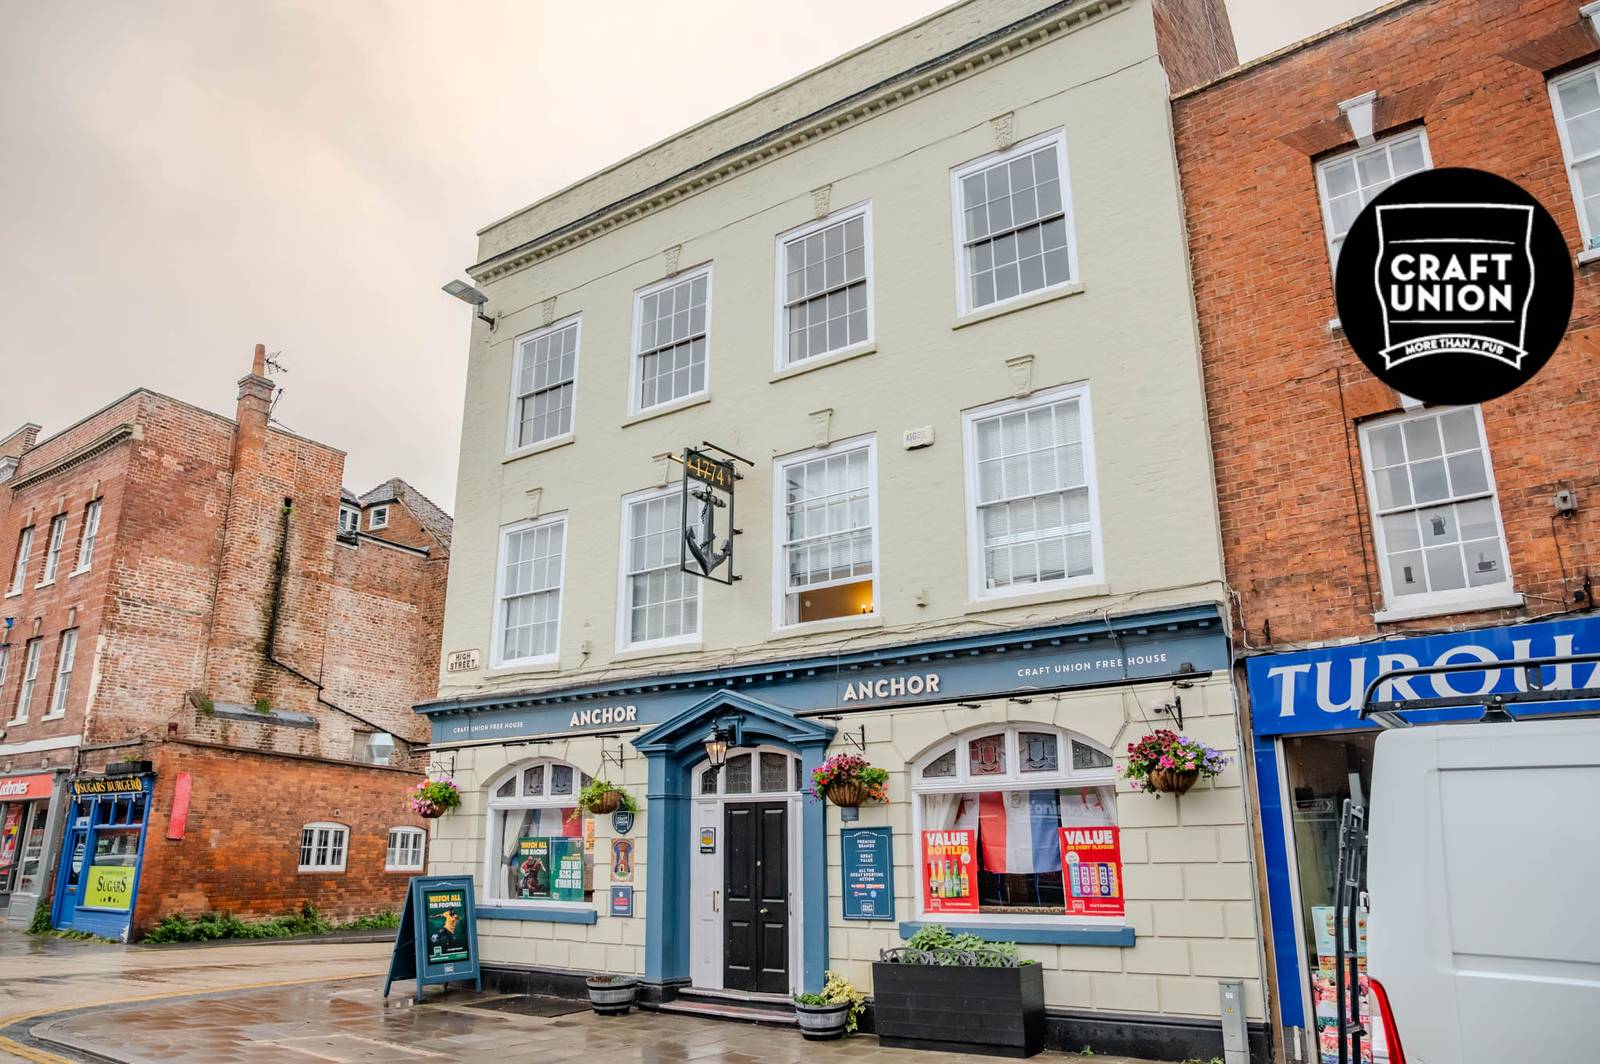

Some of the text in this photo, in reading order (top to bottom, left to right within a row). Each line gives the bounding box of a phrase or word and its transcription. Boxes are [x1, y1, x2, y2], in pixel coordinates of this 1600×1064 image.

[695, 457, 725, 487] 1774
[455, 651, 471, 661] HIGH
[1017, 653, 1167, 677] CRAFT UNION FREE HOUSE
[843, 673, 941, 701] ANCHOR
[569, 705, 638, 727] ANCHOR
[453, 721, 524, 734] CRAFT UNION FREE HOUSE
[926, 832, 969, 846] VALUE
[1064, 829, 1114, 845] VALUE
[927, 845, 970, 855] BOTTLED
[450, 893, 462, 902] ALL
